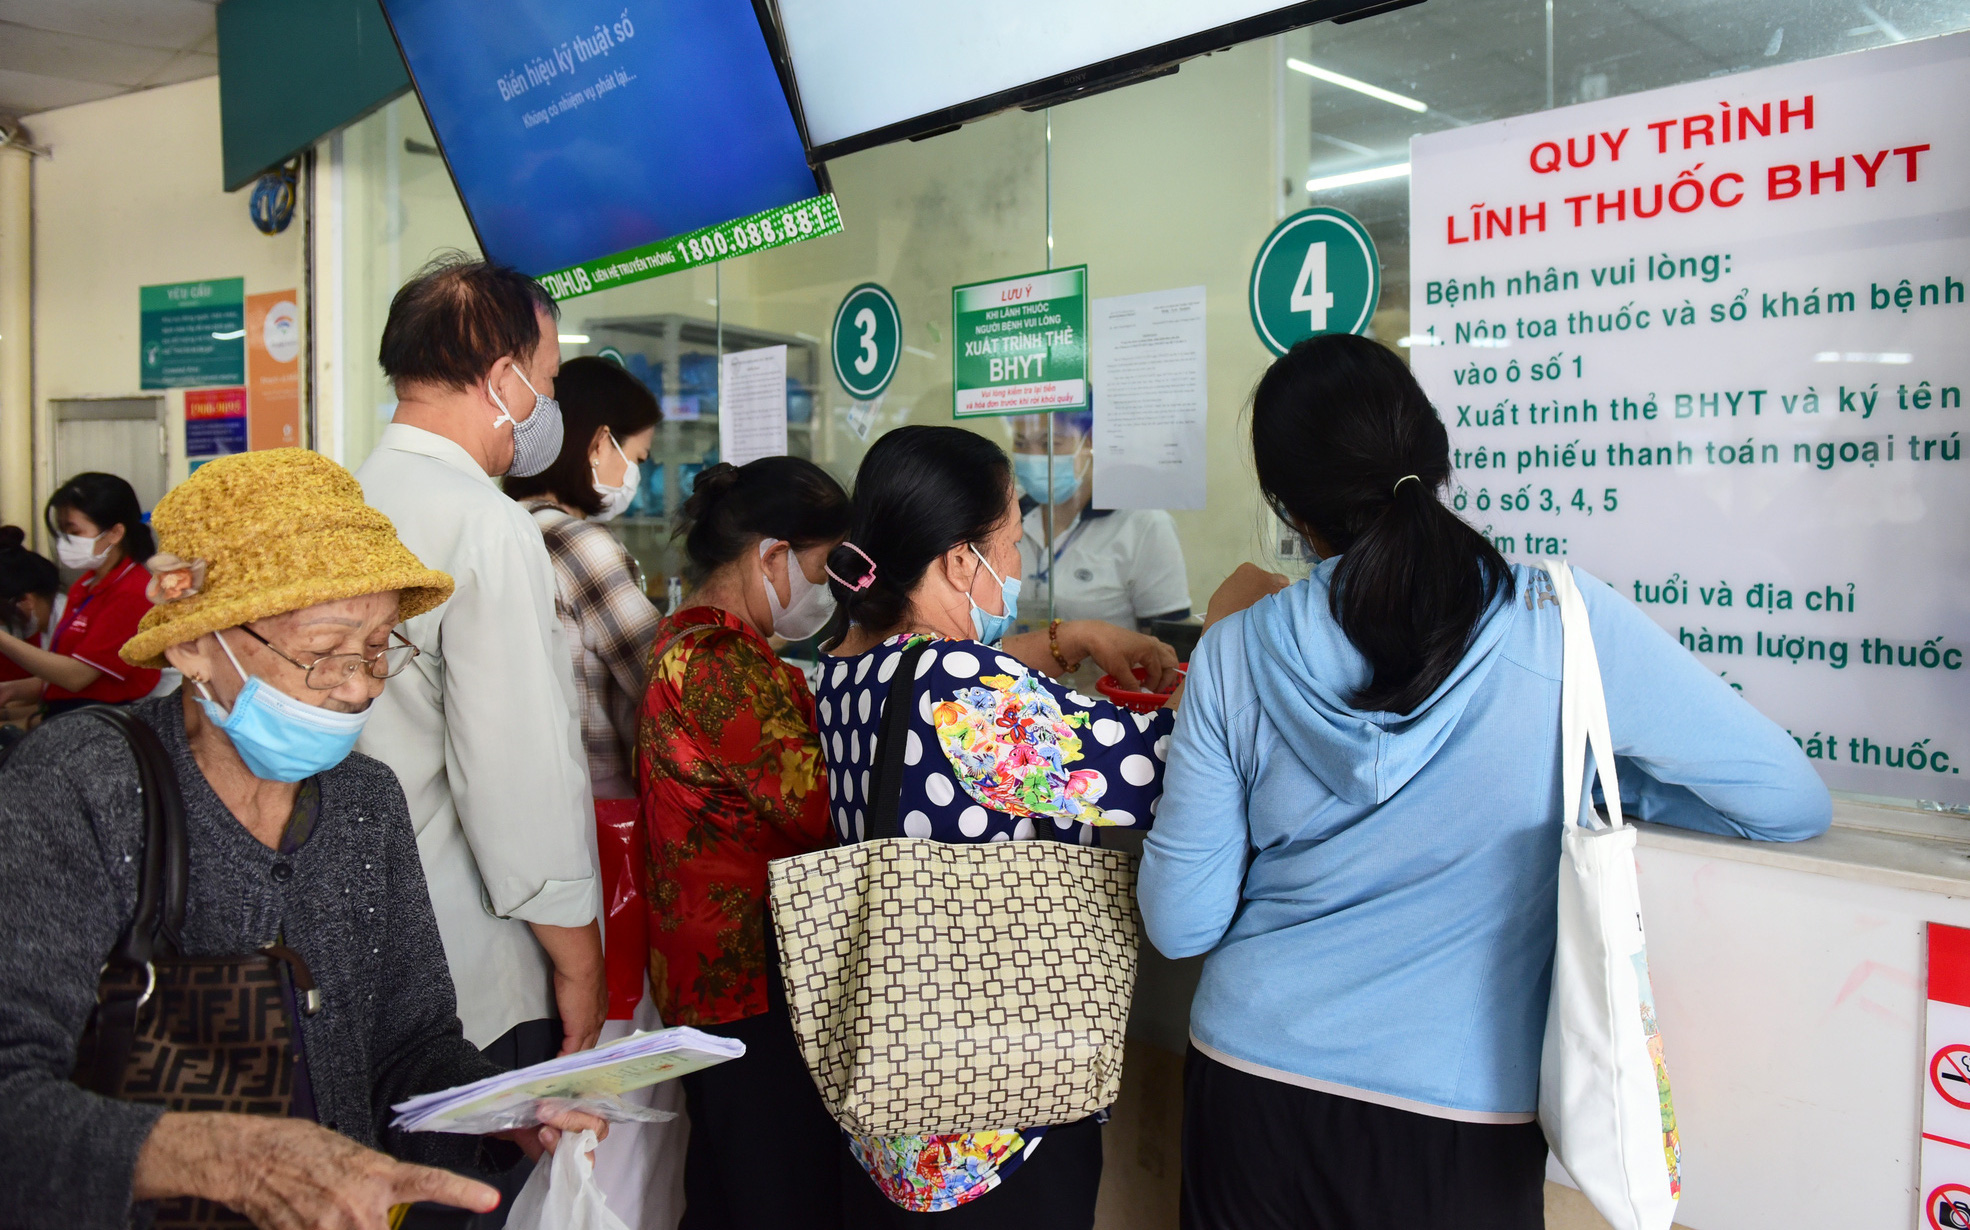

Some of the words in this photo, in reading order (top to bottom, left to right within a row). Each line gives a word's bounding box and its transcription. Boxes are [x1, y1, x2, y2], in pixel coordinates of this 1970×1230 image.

[497, 69, 529, 101] Biển
[524, 56, 557, 86] hiệu
[553, 42, 575, 74] kỹ
[573, 25, 615, 62] thuật
[613, 7, 635, 43] số
[1063, 72, 1087, 86] SONY
[522, 109, 550, 129] Không
[548, 100, 559, 117] có
[558, 91, 585, 112] nhiệm
[584, 86, 596, 101] vụ
[595, 74, 617, 98] phát
[1529, 128, 1630, 174] QUY
[1647, 95, 1815, 154] TRÌNH
[1447, 202, 1547, 245] LĨNH
[1564, 162, 1745, 228] THUỐC
[1767, 144, 1931, 202] BHYT
[677, 206, 826, 264] 1800.088.881
[1001, 287, 1024, 302] LƯU
[1026, 284, 1033, 298] Ý
[1290, 241, 1334, 332] 4
[1426, 276, 1496, 308] Bệnh
[1507, 267, 1580, 297] nhân
[1591, 257, 1636, 287] vui
[1648, 250, 1733, 283] lòng:
[986, 311, 999, 320] KHI
[1024, 319, 1037, 329] VUI
[1516, 318, 1558, 340] toa
[1567, 305, 1651, 335] thuốc
[1662, 300, 1696, 327] và
[1711, 288, 1750, 323] sổ
[1762, 288, 1856, 319] khám
[1871, 276, 1965, 314] bệnh
[854, 308, 878, 375] 3
[1003, 331, 1042, 350] TRÌNH
[1045, 325, 1074, 347] THẺ
[989, 353, 1047, 382] BHYT
[1453, 362, 1498, 386] vào
[1506, 359, 1522, 383] ô
[1530, 352, 1563, 382] số
[1572, 355, 1583, 379] 1
[1457, 398, 1519, 428] Xuất
[1529, 398, 1598, 425] trình
[1610, 393, 1659, 422] thẻ
[1675, 389, 1768, 418] BHYT
[1781, 386, 1820, 414] và
[1839, 383, 1878, 418] ký
[1898, 381, 1961, 411] tên
[1454, 446, 1507, 469] trên
[1517, 439, 1597, 475] phiếu
[1607, 441, 1693, 467] thanh
[1706, 438, 1779, 465] toán
[1794, 434, 1895, 471] ngoại
[1909, 431, 1961, 461] trú
[1454, 485, 1468, 511] ở
[1476, 488, 1492, 512] ô
[1500, 484, 1533, 512] số
[1540, 488, 1561, 516] 3,
[1571, 488, 1594, 516] 4,
[1603, 488, 1619, 512] 5
[1525, 532, 1568, 555] tra:
[1633, 573, 1689, 605] tuổi
[1699, 580, 1734, 608] và
[1745, 582, 1794, 615] địa
[1805, 582, 1856, 613] chỉ
[1679, 626, 1744, 655] hàm
[1757, 630, 1849, 670] lượng
[1861, 636, 1963, 671] thuốc
[1849, 737, 1960, 774] thuốc.
